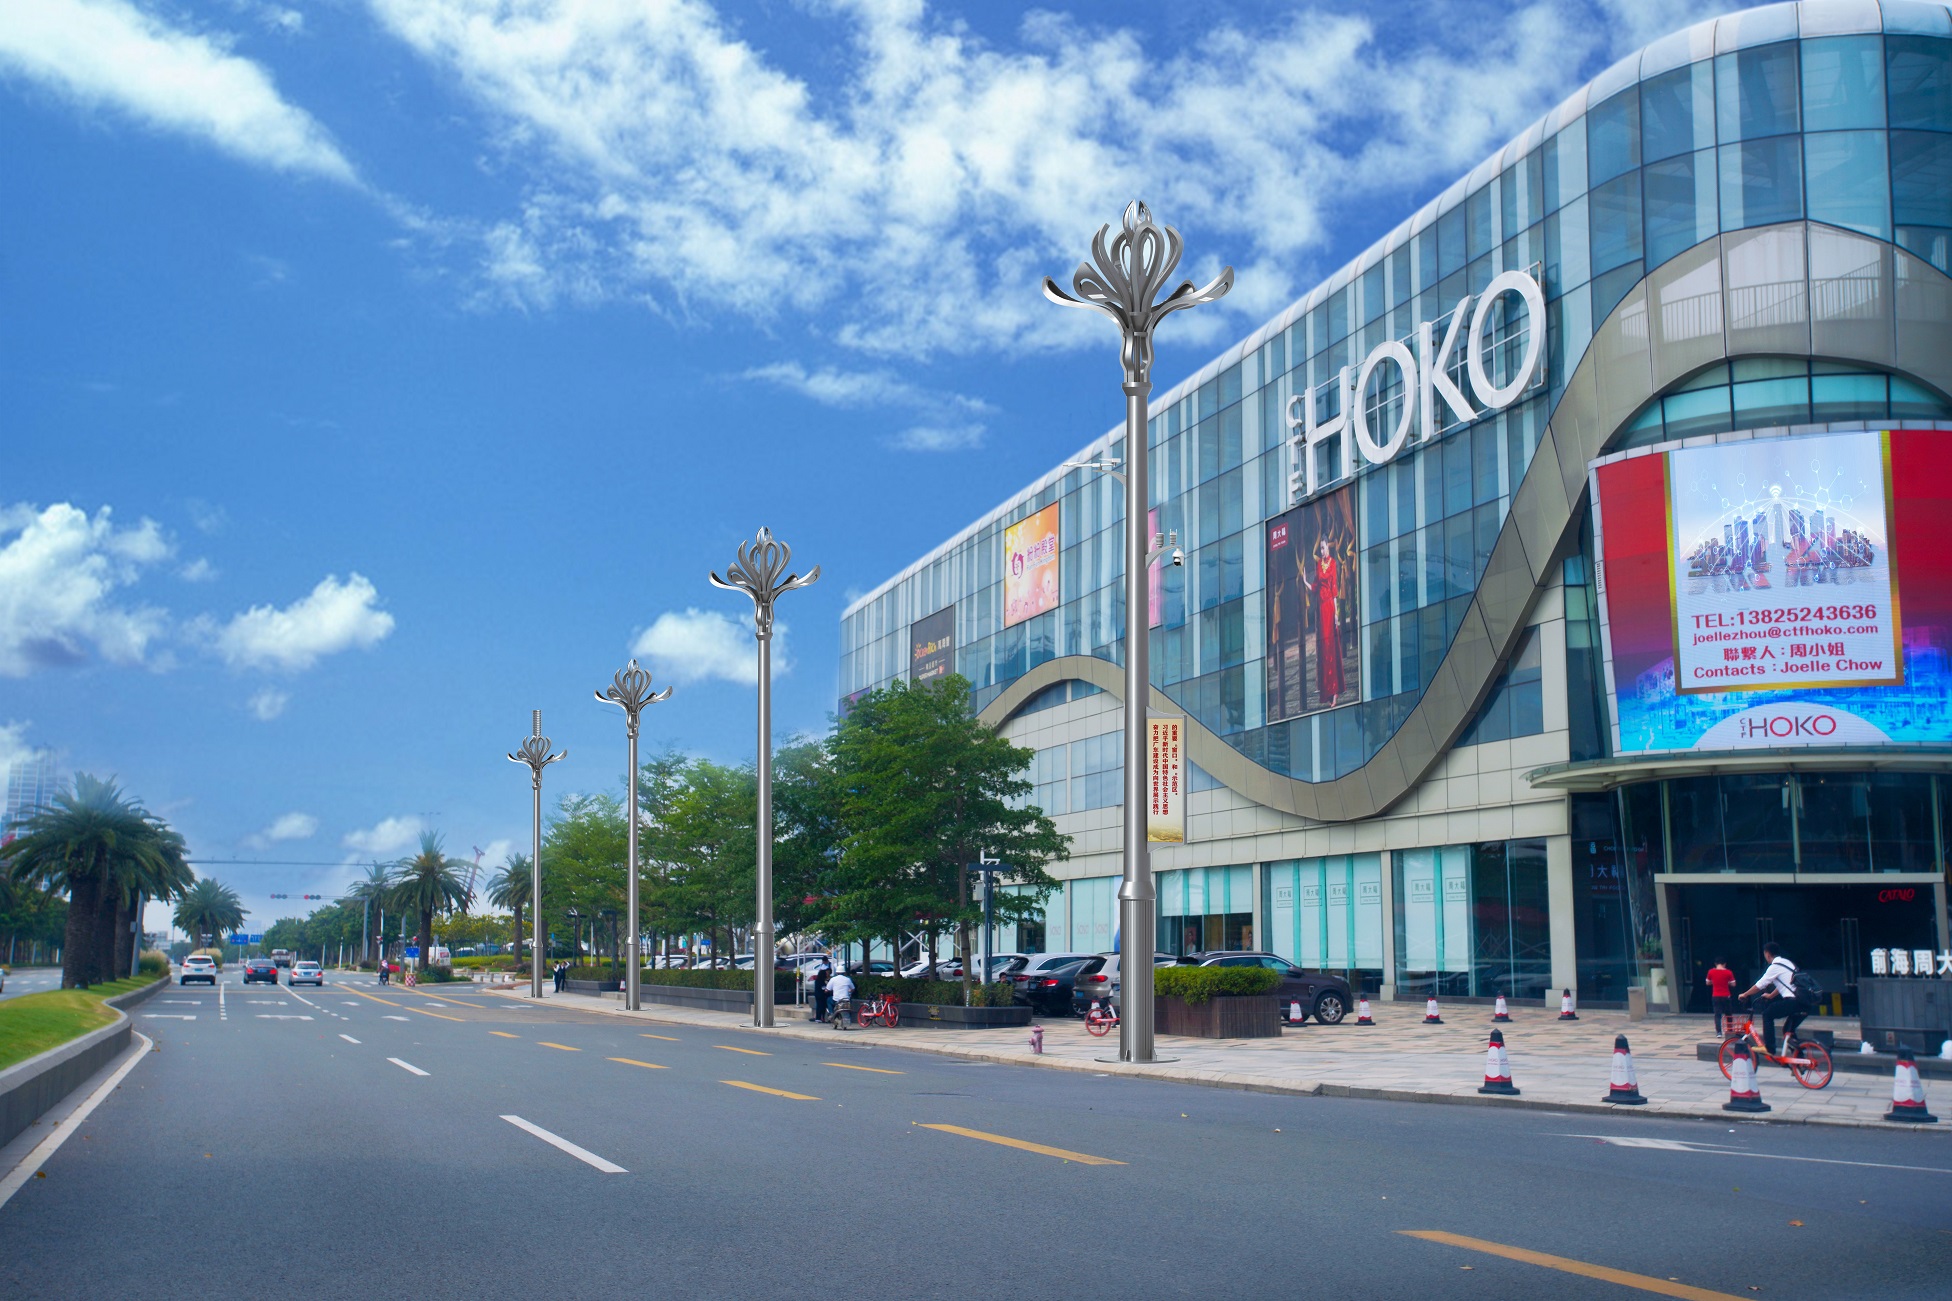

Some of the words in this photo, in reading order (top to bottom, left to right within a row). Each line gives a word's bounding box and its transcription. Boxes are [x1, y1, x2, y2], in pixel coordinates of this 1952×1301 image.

[1305, 270, 1546, 496] HOKO
[1691, 604, 1877, 629] TEL:13825243636
[1692, 624, 1879, 646] joellezhou@ctfhoko.com
[1835, 659, 1883, 671] Chow
[1749, 714, 1837, 738] HOKO
